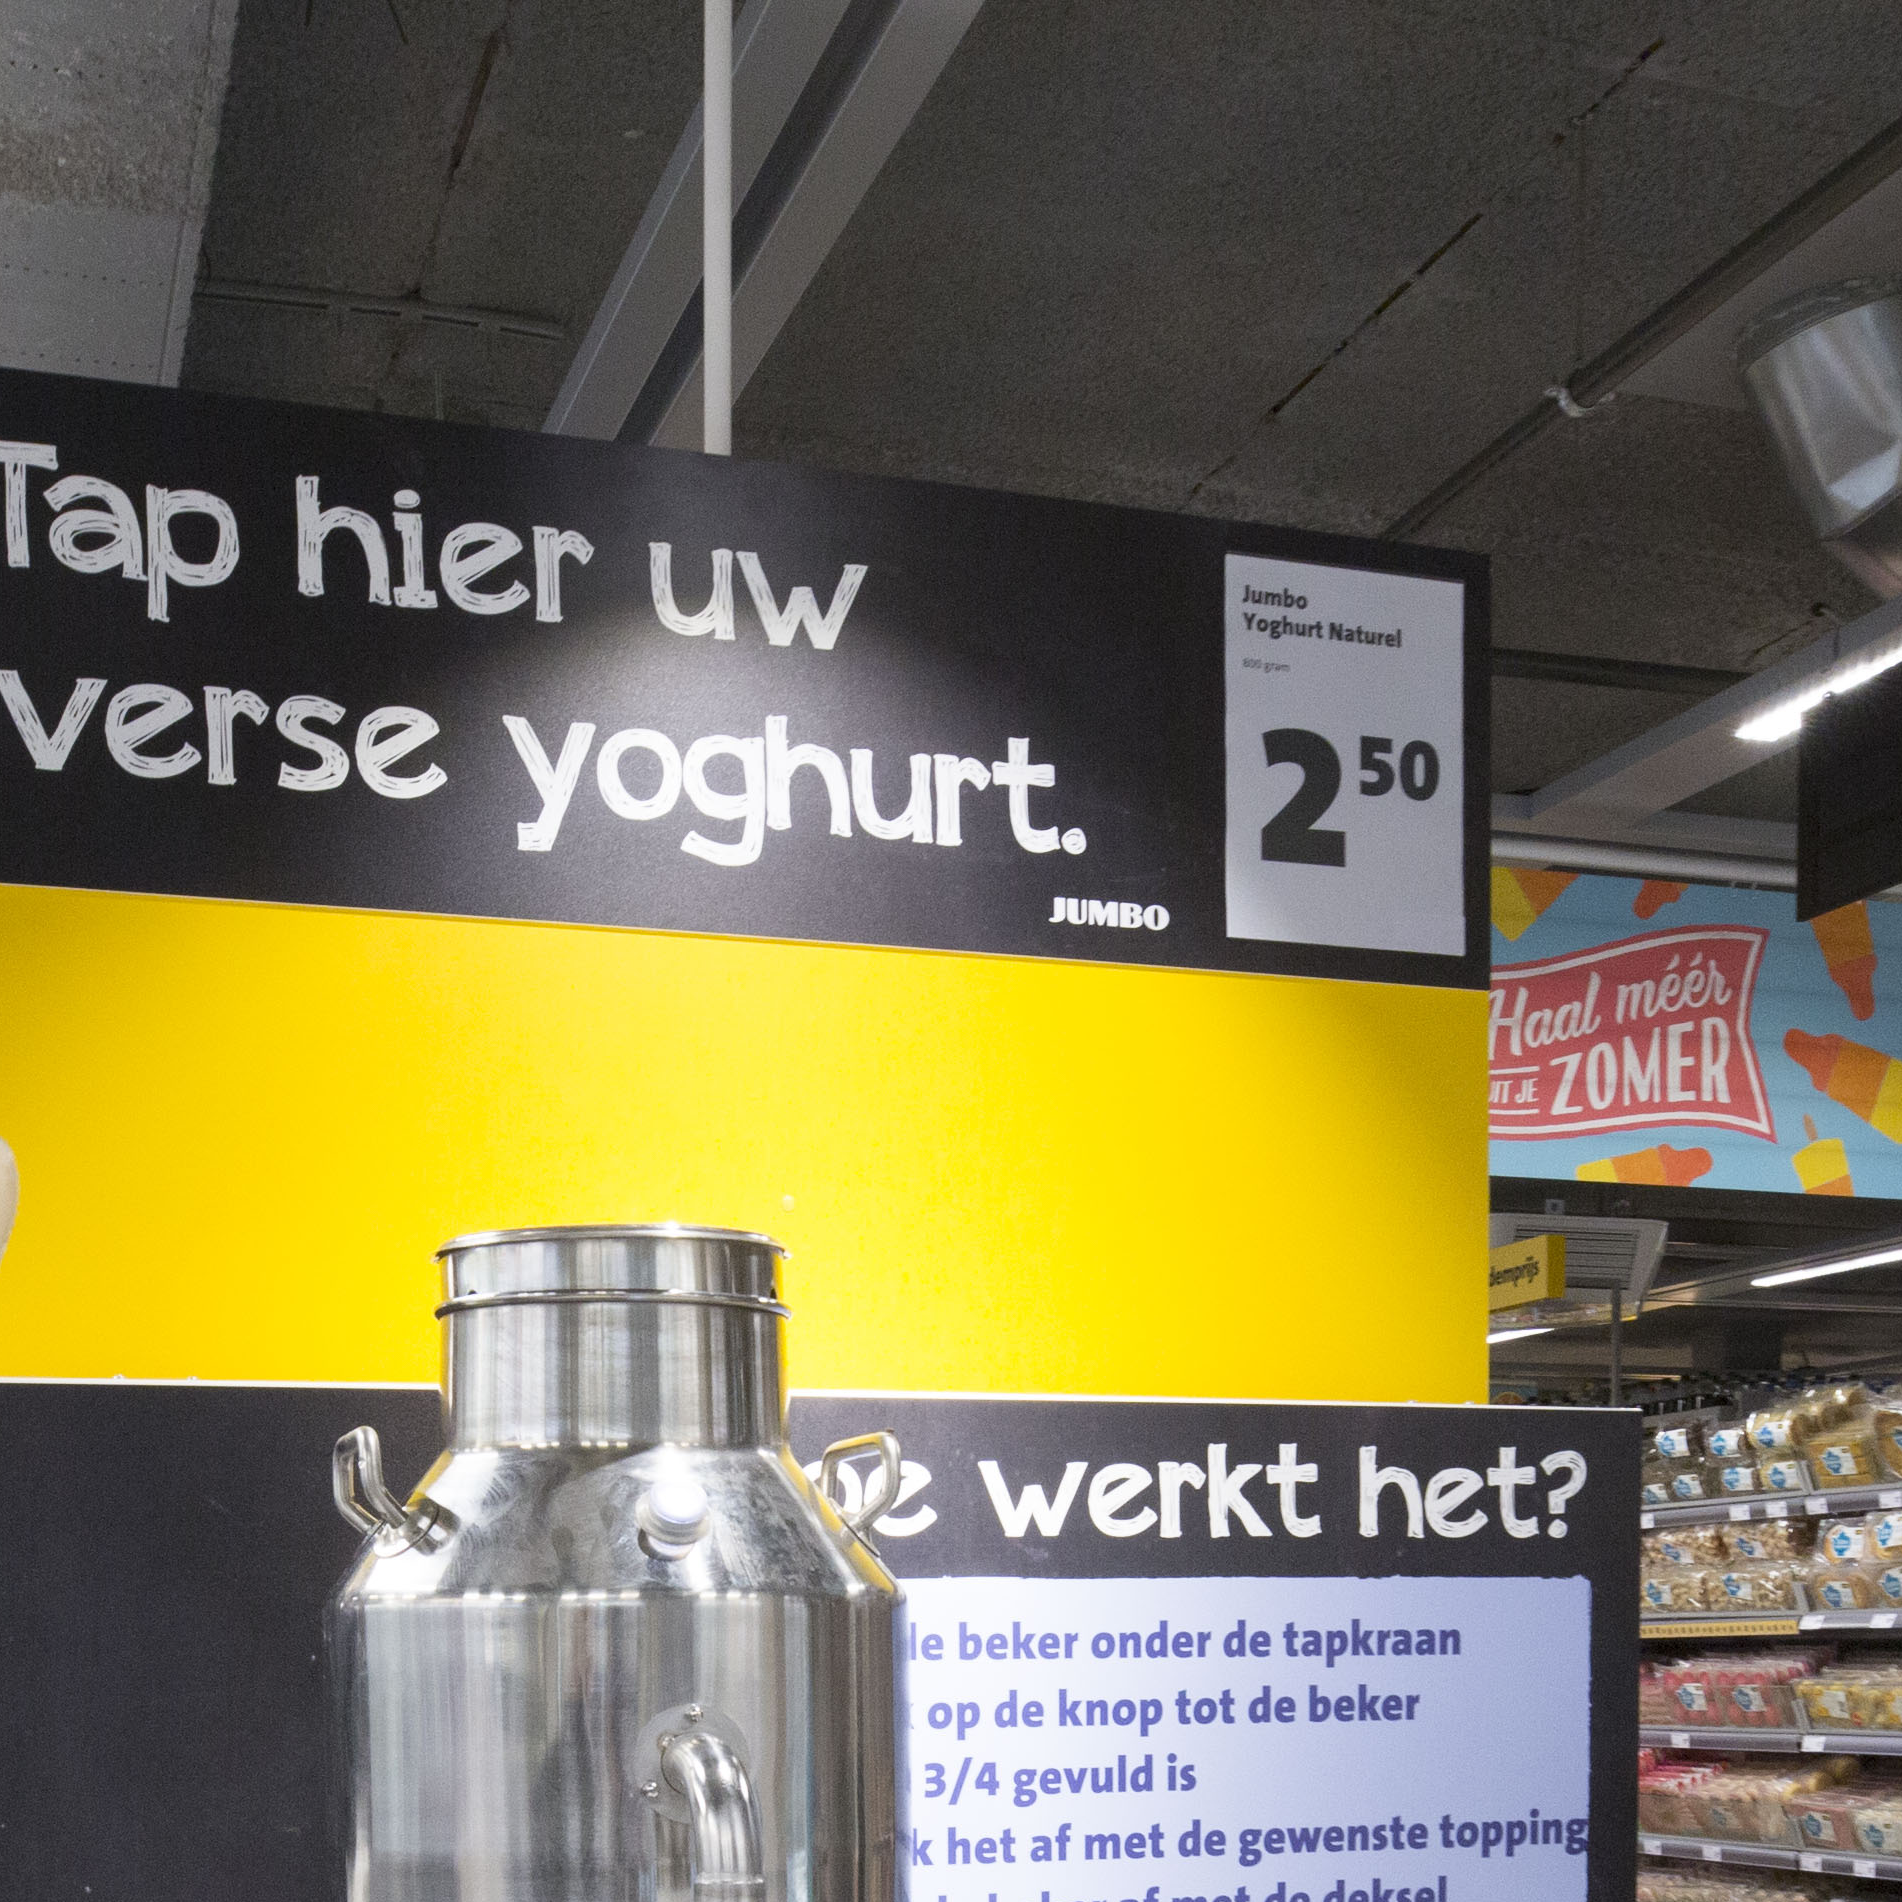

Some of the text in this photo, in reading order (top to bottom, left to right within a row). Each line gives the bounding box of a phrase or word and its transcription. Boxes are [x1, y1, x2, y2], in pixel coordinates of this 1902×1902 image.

[296, 475, 594, 623] hier
[651, 542, 867, 650] uw
[1242, 585, 1308, 609] Jumbo
[1243, 612, 1401, 648] Yoghurt Naturel
[503, 713, 1086, 868] yoghurt.
[1262, 728, 1440, 868] 2 50
[1049, 897, 1169, 931] JUMBO
[1489, 951, 1733, 1060] Haal méér
[1514, 1078, 1539, 1103] JE
[1549, 1017, 1731, 1116] ZOMER
[977, 1443, 1323, 1539] werkt
[1359, 1446, 1587, 1539] het?
[959, 1622, 1078, 1661] beker
[1092, 1620, 1211, 1659] onder
[1224, 1619, 1272, 1658] de
[1283, 1619, 1461, 1667] tapkraan
[928, 1702, 981, 1741] op
[995, 1689, 1044, 1729] de
[1059, 1689, 1163, 1738] knop
[1175, 1689, 1235, 1725] tot
[1249, 1685, 1296, 1724] de
[1310, 1684, 1421, 1722] beker
[925, 1753, 1197, 1808] 3/4 gevuld is
[948, 1827, 1016, 1864] het
[1031, 1823, 1071, 1863] af
[1084, 1823, 1164, 1861] met
[1178, 1818, 1226, 1858] de
[1239, 1816, 1429, 1867] gewenste
[1440, 1809, 1589, 1863] topping
